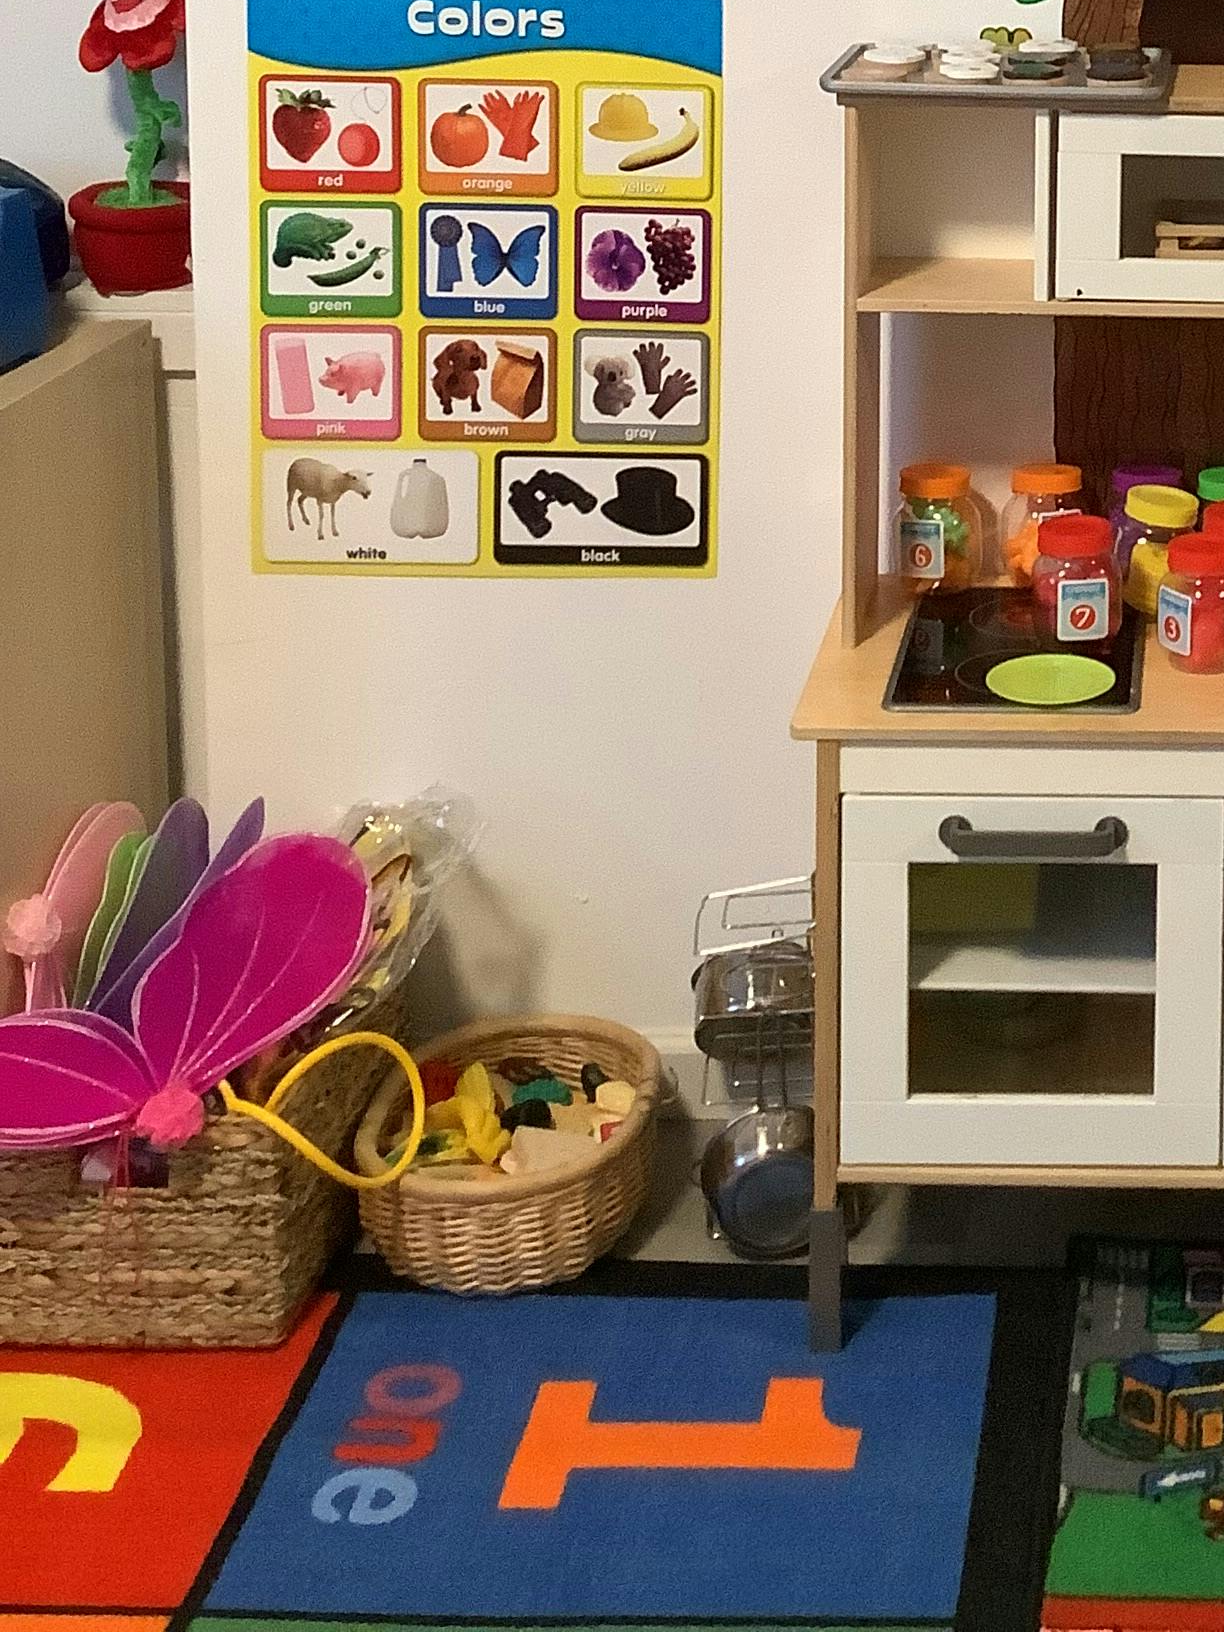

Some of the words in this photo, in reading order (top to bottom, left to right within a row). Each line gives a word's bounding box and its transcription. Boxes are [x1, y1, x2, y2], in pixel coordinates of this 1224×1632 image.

[406, 0, 566, 39] Colors
[317, 173, 344, 188] red
[461, 177, 513, 193] orange
[619, 180, 666, 196] yellow
[308, 298, 352, 314] green
[473, 300, 506, 315] blue
[621, 304, 668, 320] purple
[316, 421, 346, 437] pink
[463, 422, 509, 437] brown
[624, 426, 657, 441] gray
[346, 546, 387, 561] white
[580, 548, 620, 563] black
[914, 545, 926, 567] 6
[1075, 607, 1090, 628] 7
[1167, 618, 1178, 639] 3
[311, 1364, 463, 1527] one
[498, 1377, 864, 1511] 1
